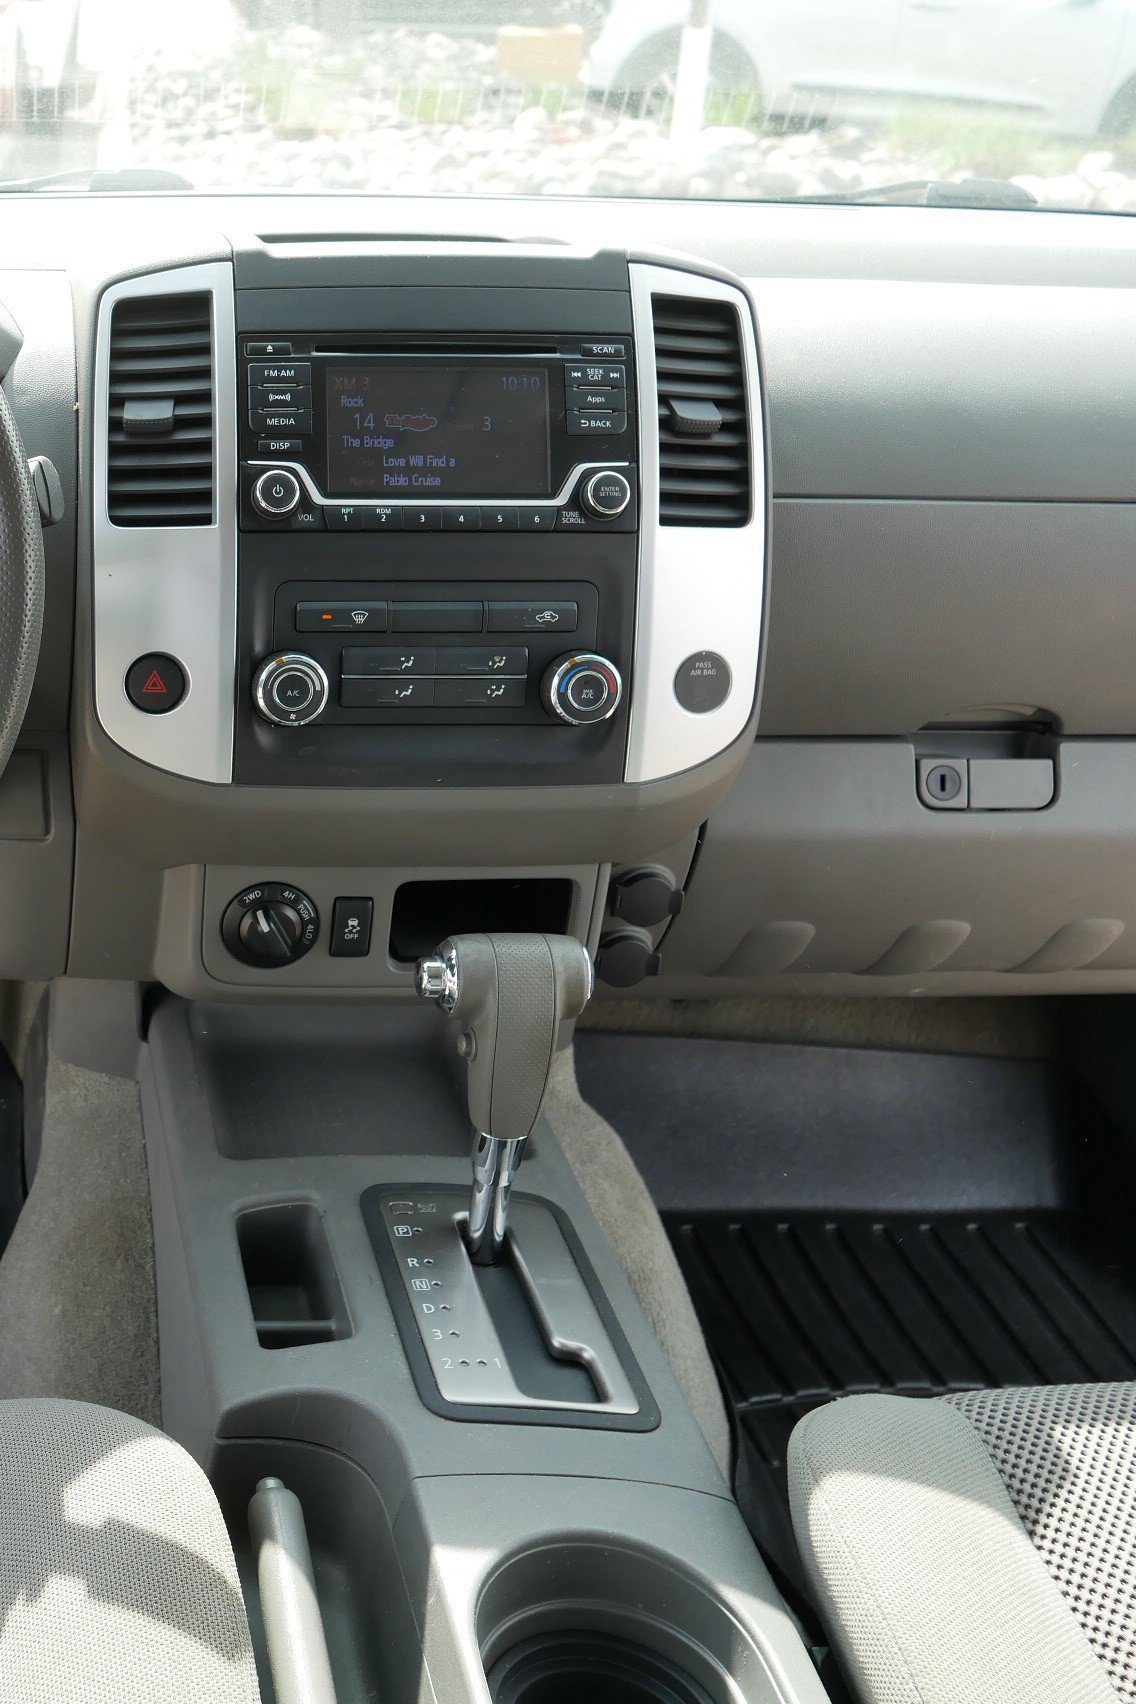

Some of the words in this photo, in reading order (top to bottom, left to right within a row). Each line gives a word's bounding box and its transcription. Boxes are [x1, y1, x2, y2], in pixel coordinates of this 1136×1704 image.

[341, 395, 364, 407] Rock
[353, 412, 375, 430] 14
[482, 416, 491, 431] 3
[590, 420, 612, 428] BACK
[270, 442, 291, 450] DISP
[342, 436, 361, 447] The
[364, 436, 395, 449] Bridge
[383, 455, 406, 467] Love
[409, 455, 423, 467] Will
[426, 455, 446, 467] Find
[449, 458, 455, 467] a
[384, 474, 409, 486] Pablo
[412, 474, 441, 486] Cruise
[695, 661, 712, 669] PASS
[243, 890, 262, 904] 2WD
[282, 890, 296, 901] 4H
[297, 904, 310, 921] PUSH
[306, 924, 314, 939] 4LO
[407, 1258, 420, 1267] R
[423, 1304, 435, 1314] D
[432, 1330, 443, 1340] 3
[442, 1359, 454, 1369] 2
[494, 1359, 502, 1368] 1
